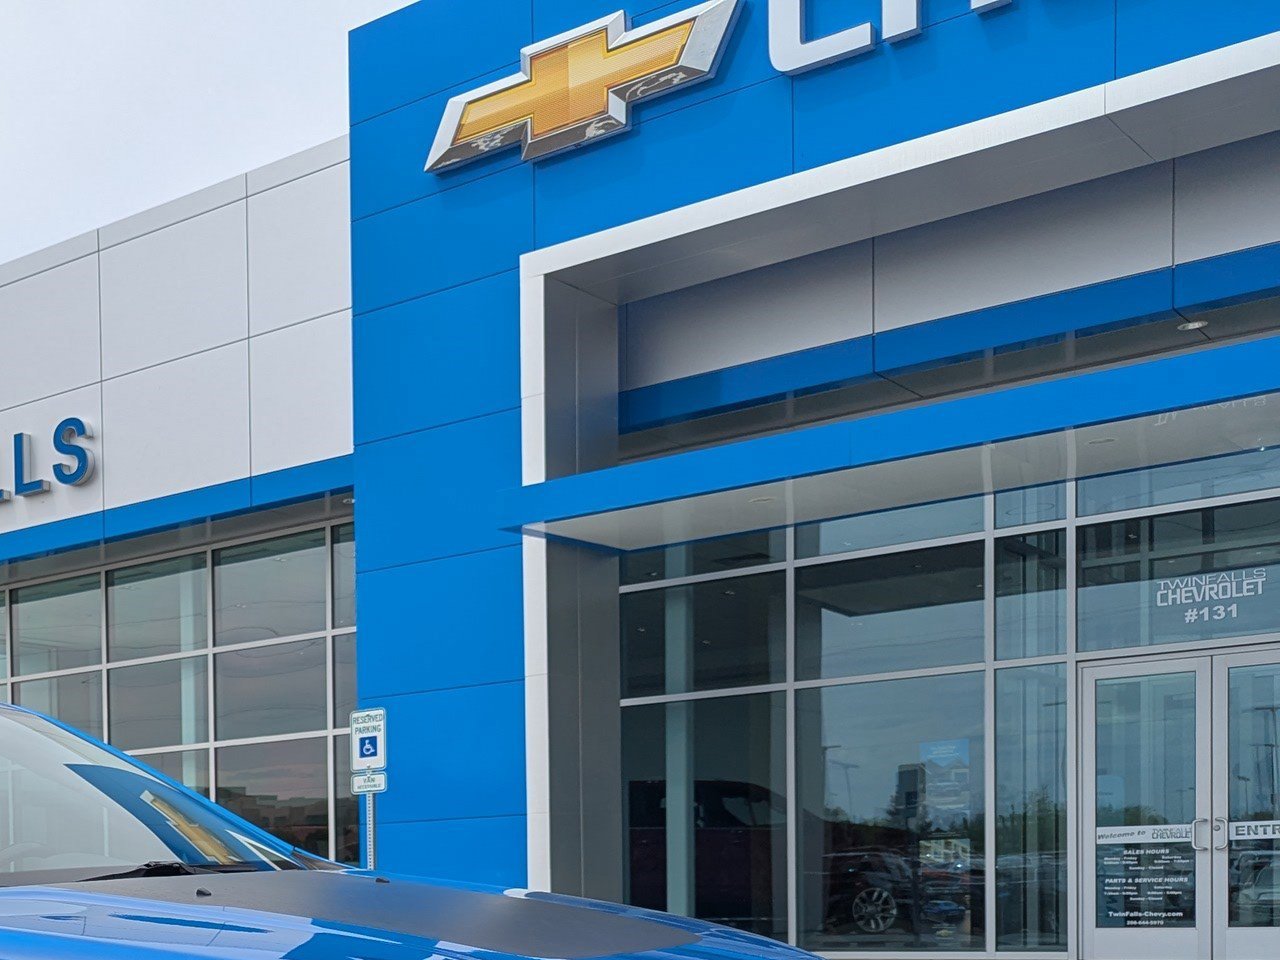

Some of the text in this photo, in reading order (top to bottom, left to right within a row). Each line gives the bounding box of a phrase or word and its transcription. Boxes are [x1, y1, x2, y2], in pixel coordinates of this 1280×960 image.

[1157, 568, 1266, 590] TWINFALLS
[1157, 578, 1266, 606] CHEVROLET
[1184, 604, 1238, 623] #131
[353, 714, 383, 725] RESERVED
[355, 725, 381, 735] PARKING
